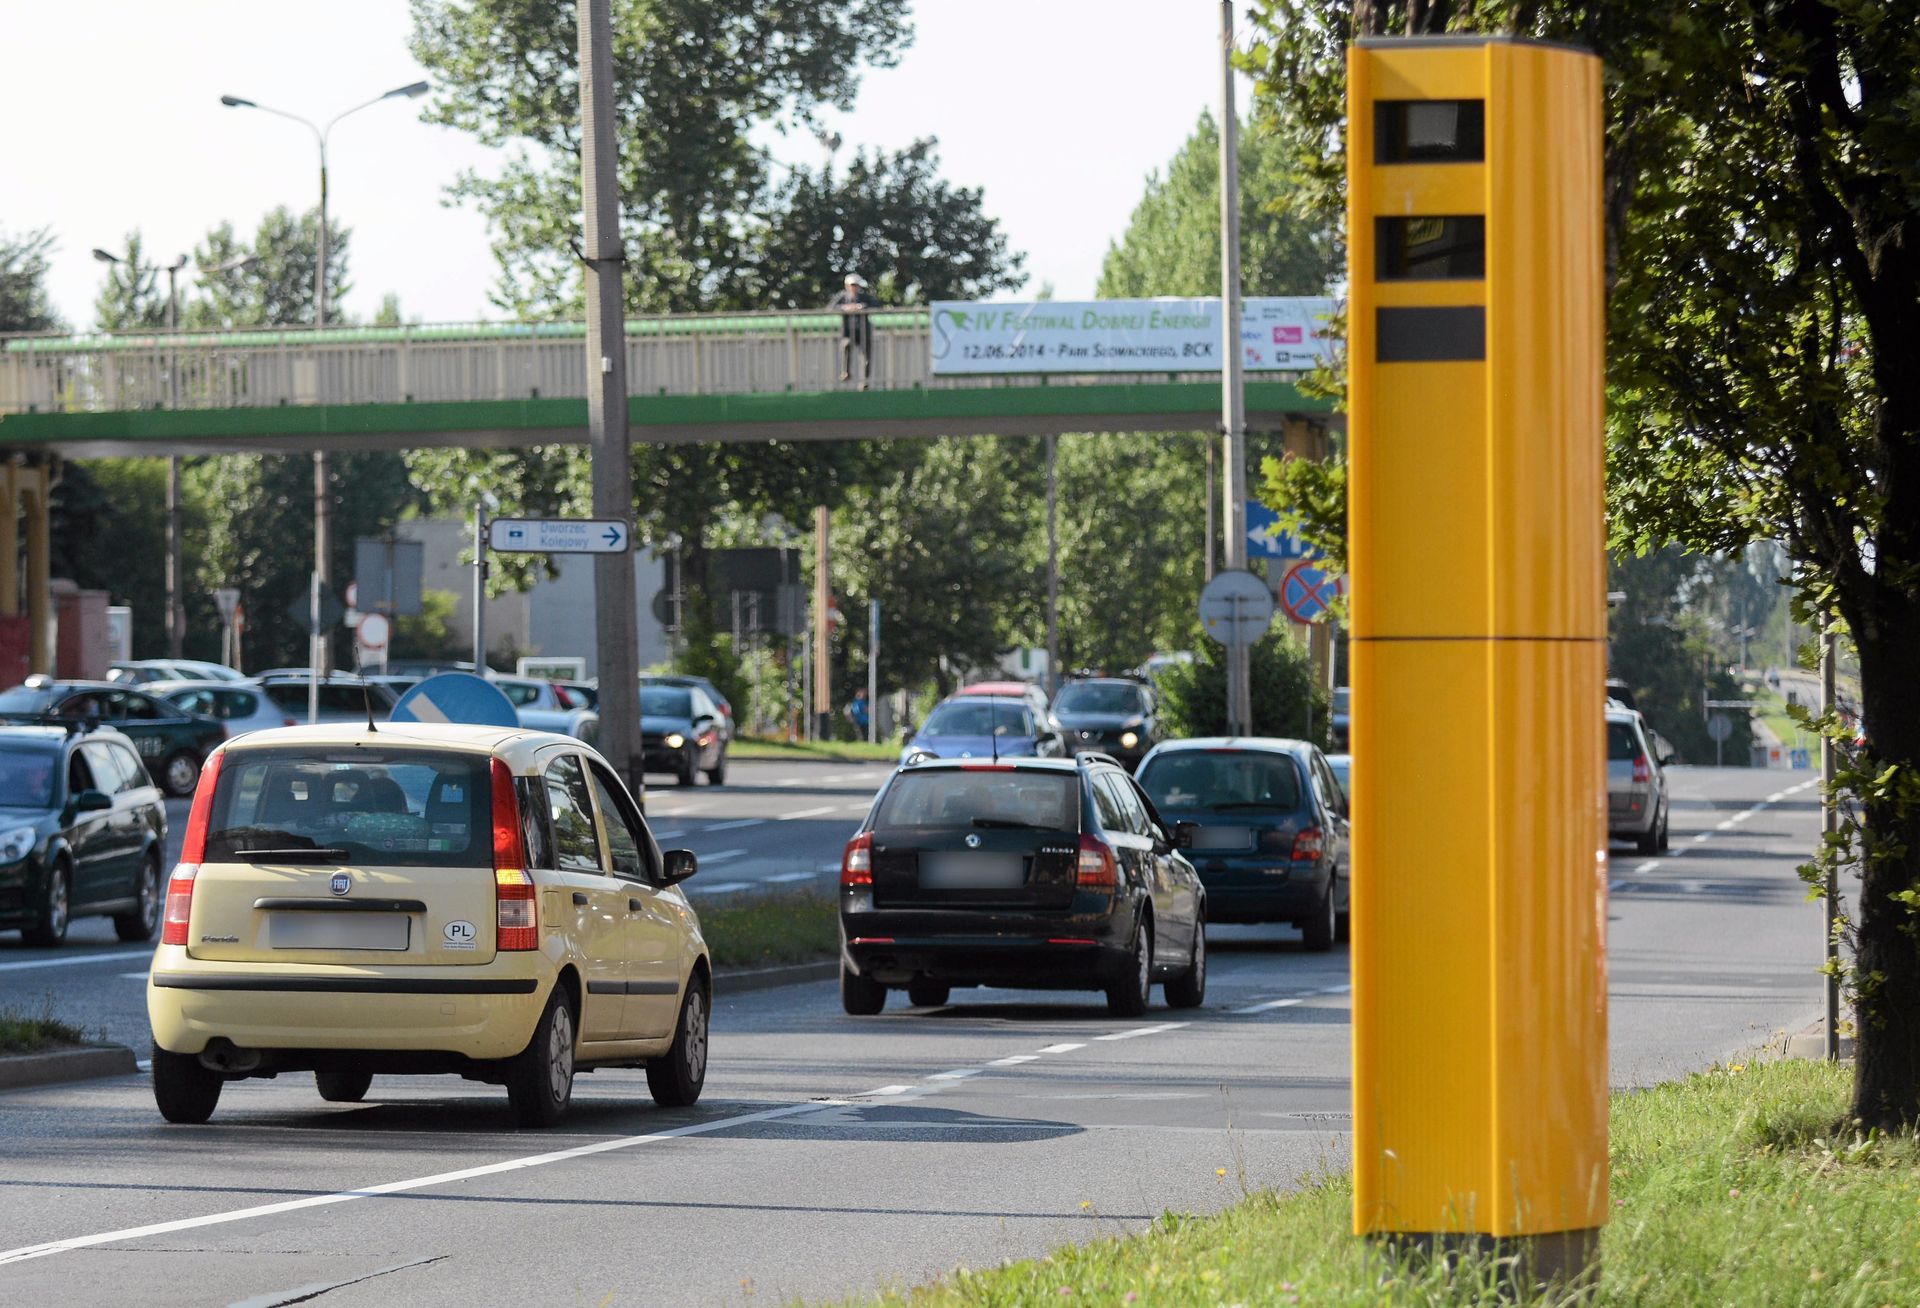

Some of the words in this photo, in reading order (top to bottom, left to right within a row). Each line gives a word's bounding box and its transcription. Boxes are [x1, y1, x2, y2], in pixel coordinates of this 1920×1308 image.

[975, 311, 998, 331] IV
[1182, 341, 1214, 358] BCK
[541, 522, 587, 533] Dworzec
[540, 535, 589, 549] Kolejowy
[452, 925, 470, 937] PL
